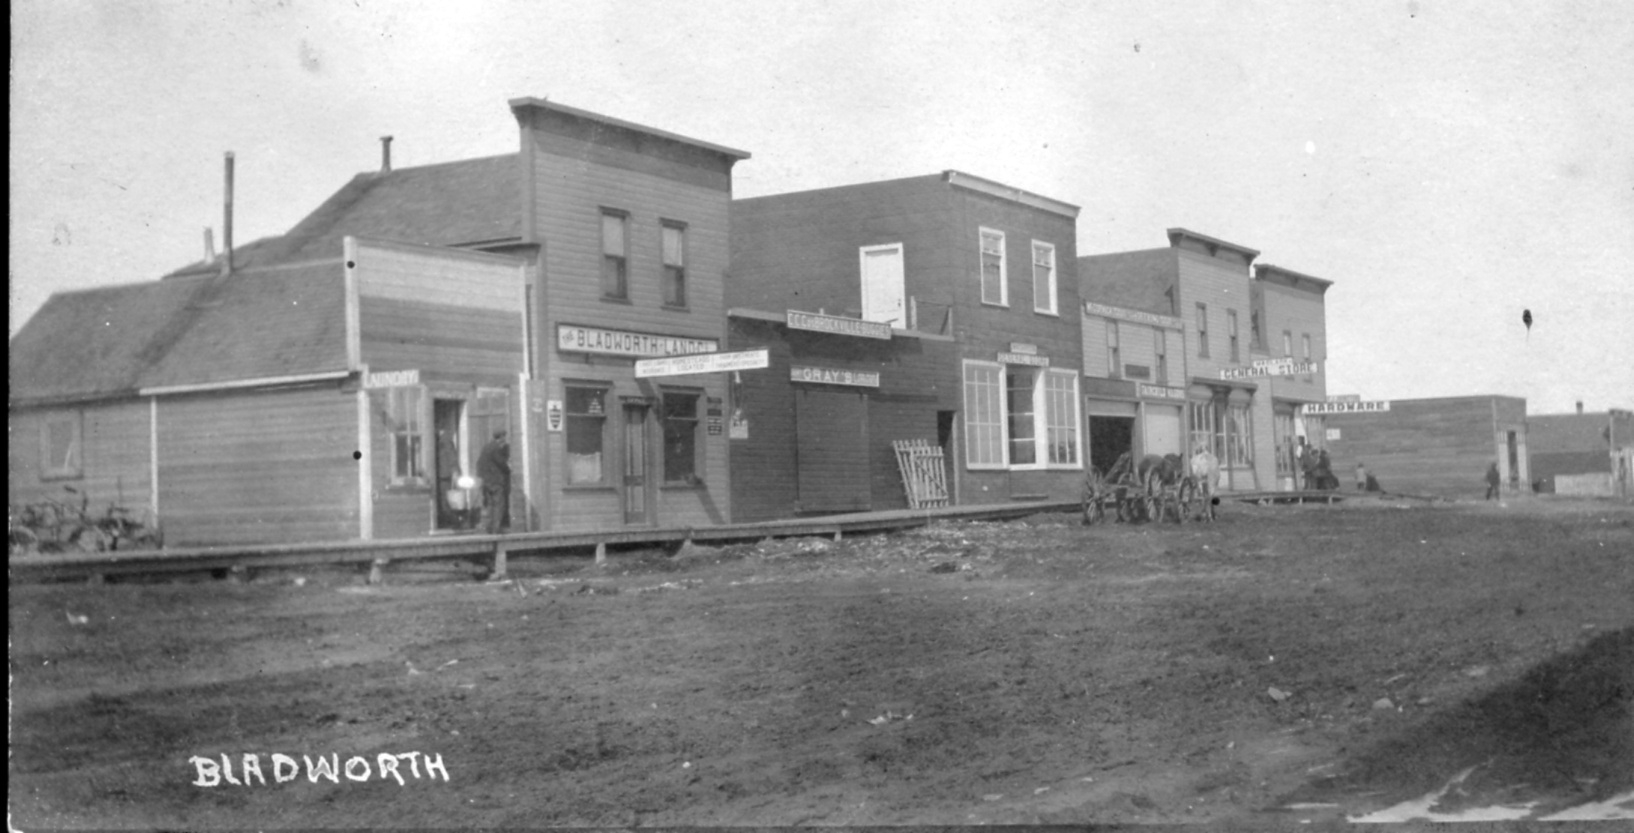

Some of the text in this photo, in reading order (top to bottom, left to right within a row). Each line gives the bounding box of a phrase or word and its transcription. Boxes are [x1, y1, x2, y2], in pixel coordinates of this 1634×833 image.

[577, 329, 659, 353] BLADWORTH
[803, 368, 852, 384] GRAY'S
[1224, 363, 1312, 379] GENERAL STORE
[1308, 401, 1382, 412] HARDWARE
